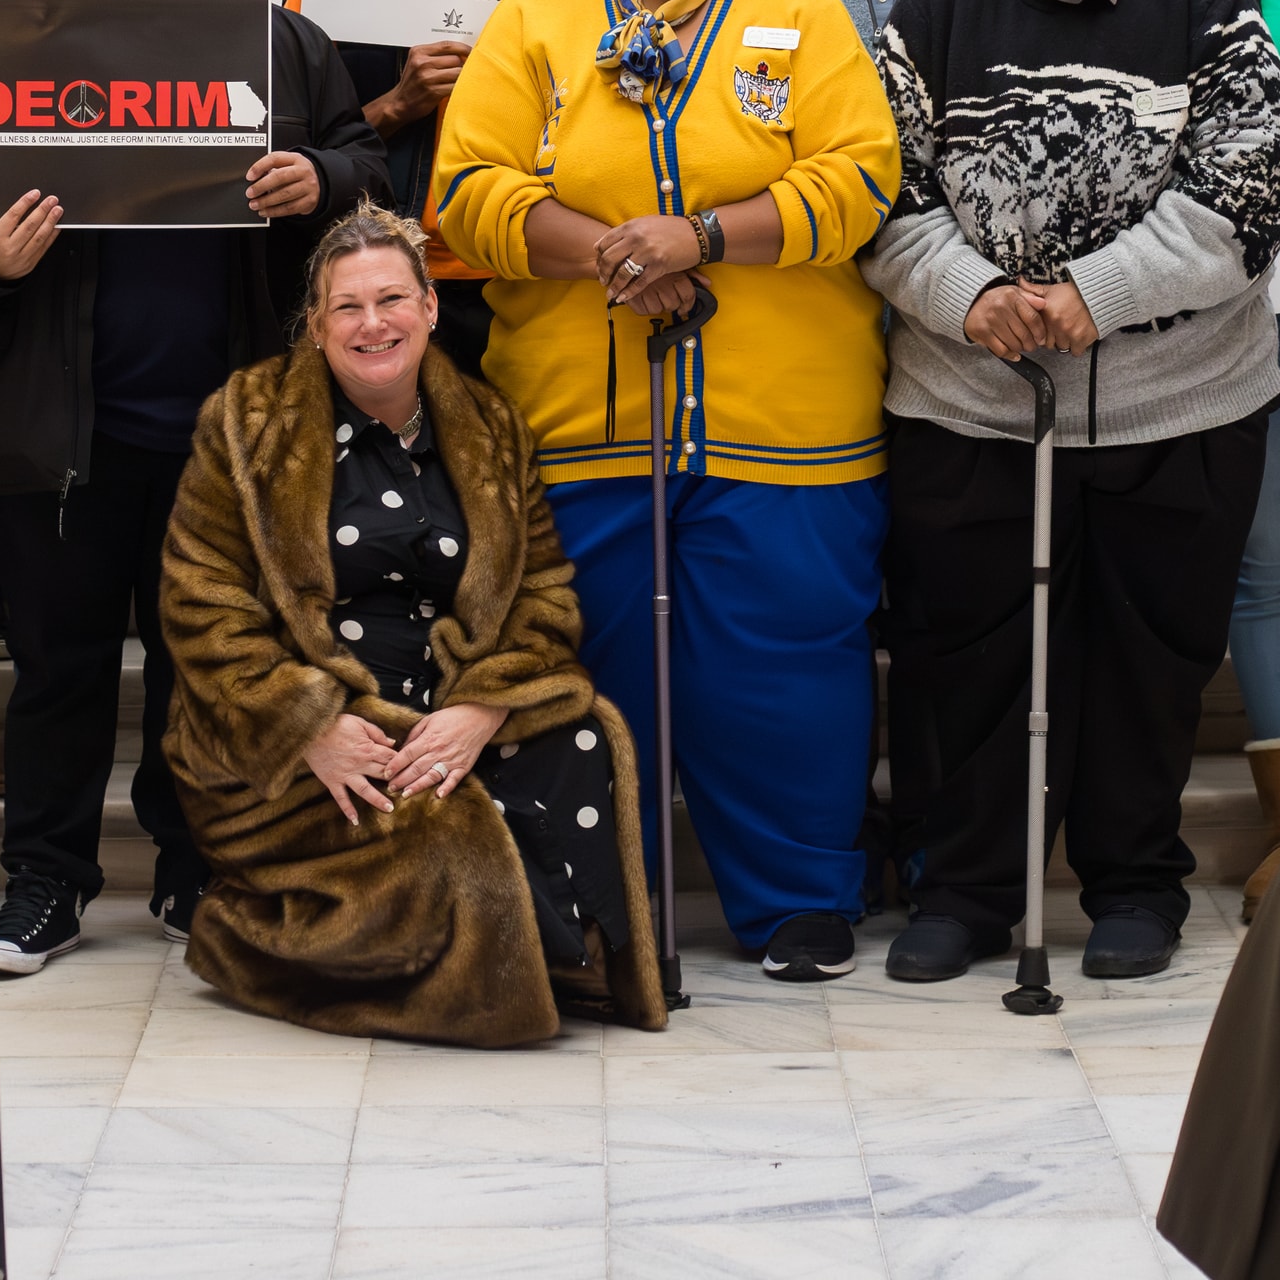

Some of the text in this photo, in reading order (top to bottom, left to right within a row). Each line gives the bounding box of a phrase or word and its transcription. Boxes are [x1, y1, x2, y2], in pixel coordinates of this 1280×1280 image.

[31, 135, 37, 144] &
[38, 135, 75, 144] CRIMINAL
[76, 135, 108, 144] JUSTICE
[110, 135, 144, 144] REFORM
[145, 135, 186, 144] INITIATIVE.
[187, 135, 210, 144] YOUR
[212, 135, 233, 144] VOTE
